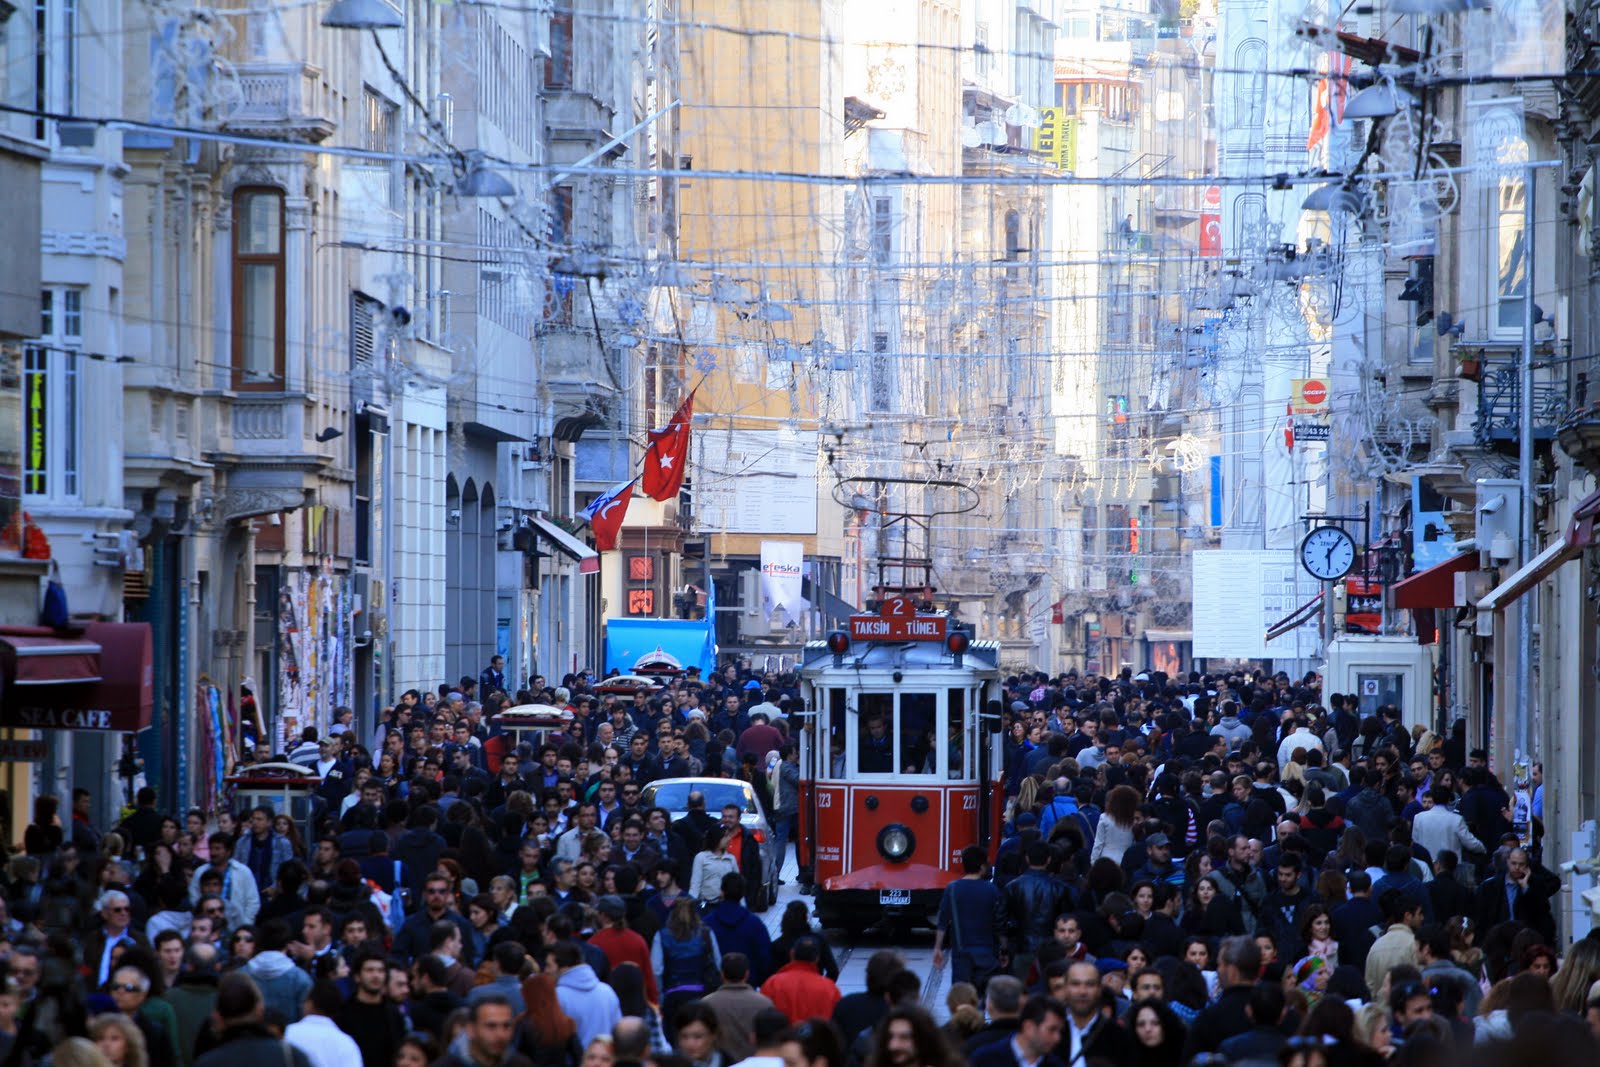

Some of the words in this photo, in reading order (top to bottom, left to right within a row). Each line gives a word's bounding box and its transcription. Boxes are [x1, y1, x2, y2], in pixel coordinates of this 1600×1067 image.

[762, 563, 800, 577] efeska
[893, 599, 904, 615] 2
[854, 620, 890, 635] TAKSİM
[906, 620, 940, 635] TÜNEL
[61, 709, 111, 728] CAFE
[818, 793, 831, 808] 223
